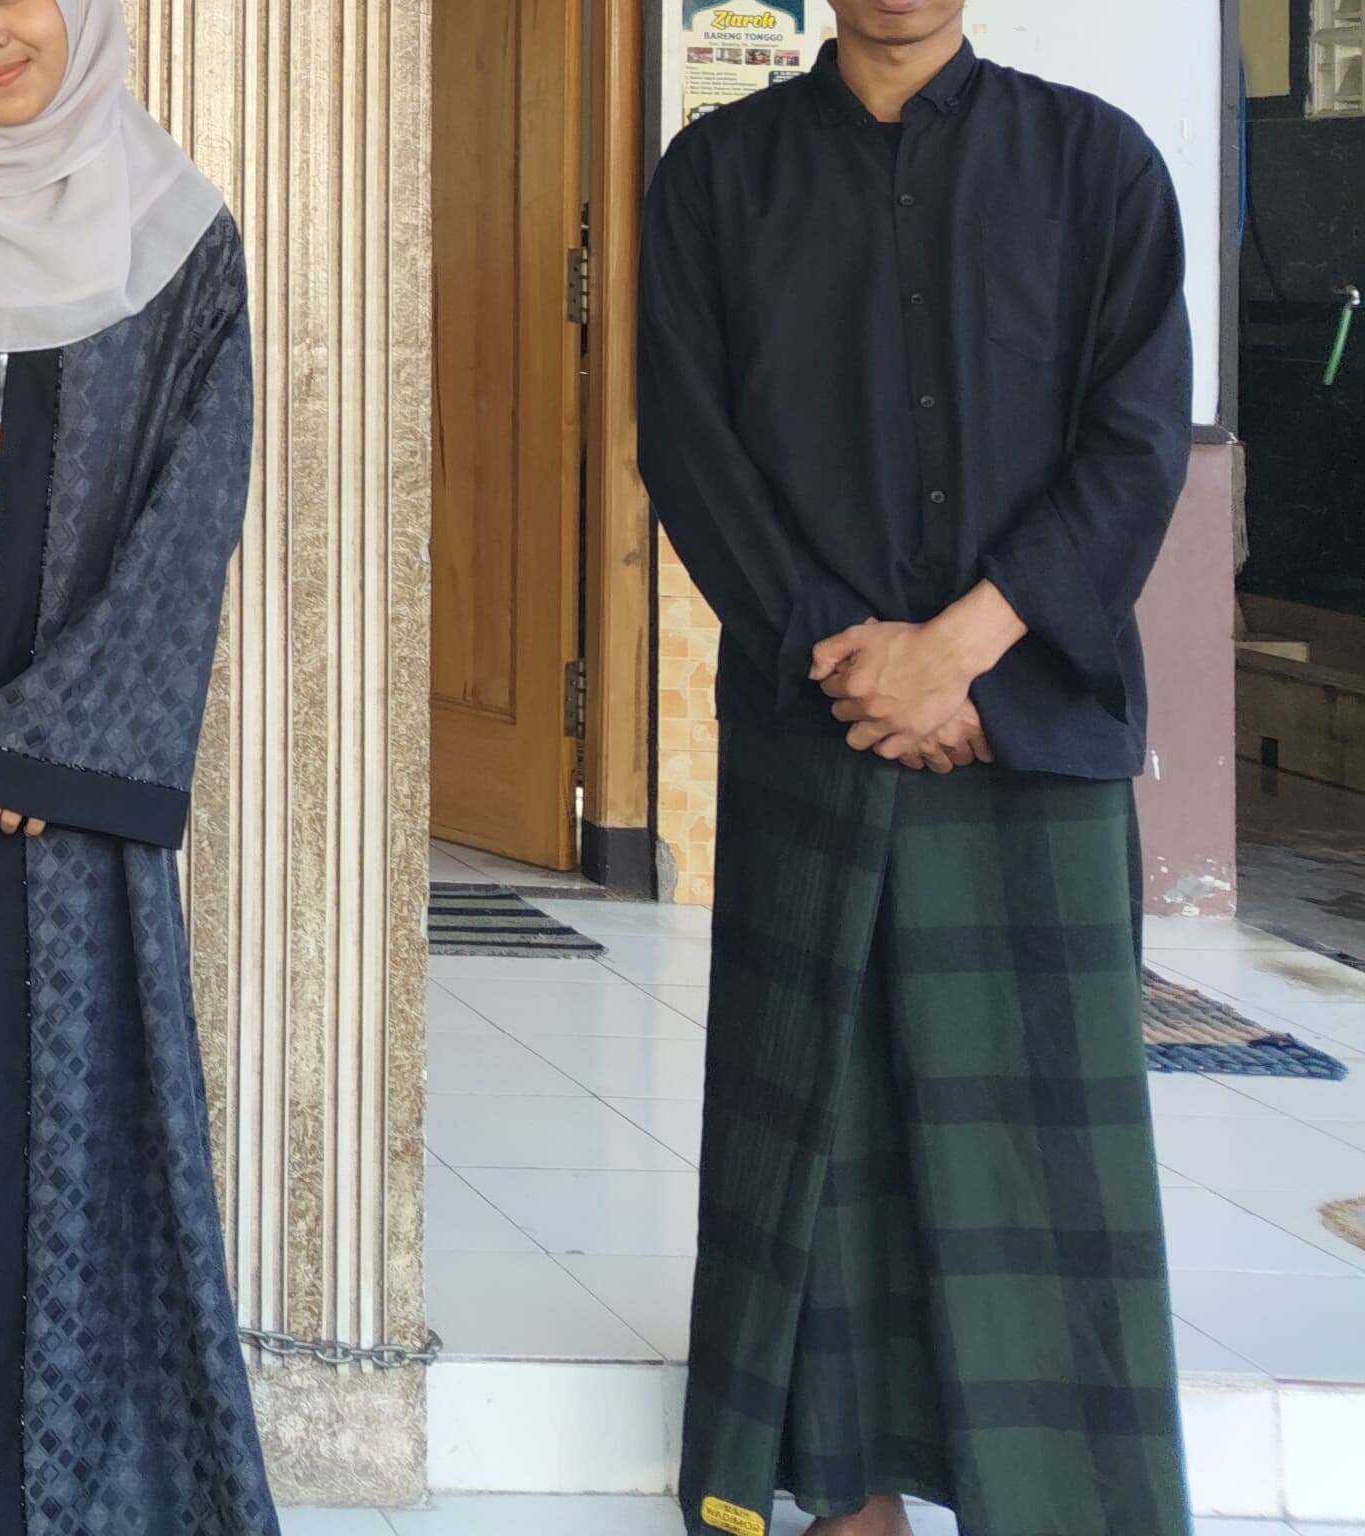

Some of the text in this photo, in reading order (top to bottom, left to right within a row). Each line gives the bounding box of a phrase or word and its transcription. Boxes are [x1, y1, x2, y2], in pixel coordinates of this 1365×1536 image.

[710, 10, 777, 30] Ziaroh
[704, 32, 783, 41] BARENG TONGGO
